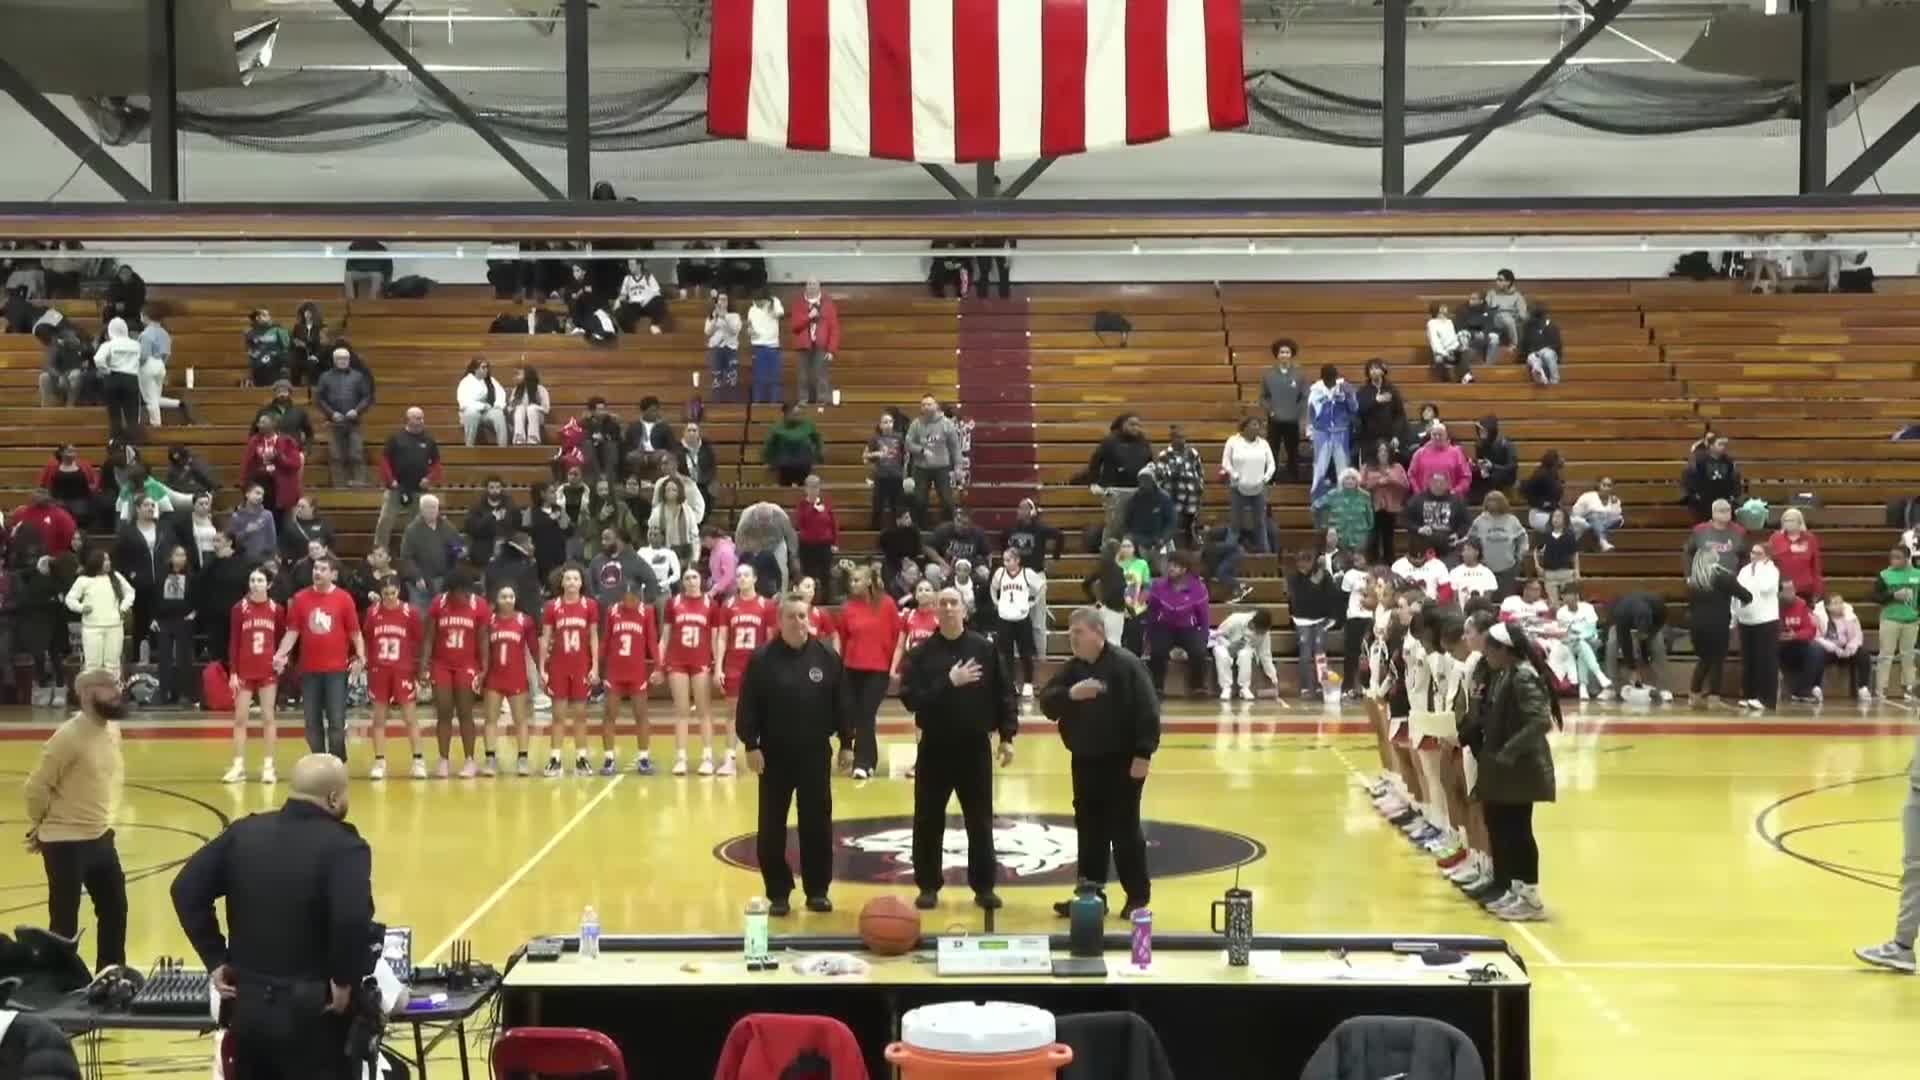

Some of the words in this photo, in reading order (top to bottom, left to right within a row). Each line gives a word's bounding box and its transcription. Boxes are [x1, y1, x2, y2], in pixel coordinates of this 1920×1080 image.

[252, 631, 265, 655] 2
[445, 629, 465, 649] 31
[562, 630, 580, 653] 14
[618, 633, 632, 657] 3
[681, 625, 700, 648] 21
[735, 626, 756, 649] 23
[377, 637, 401, 661] 33
[500, 642, 507, 665] 1
